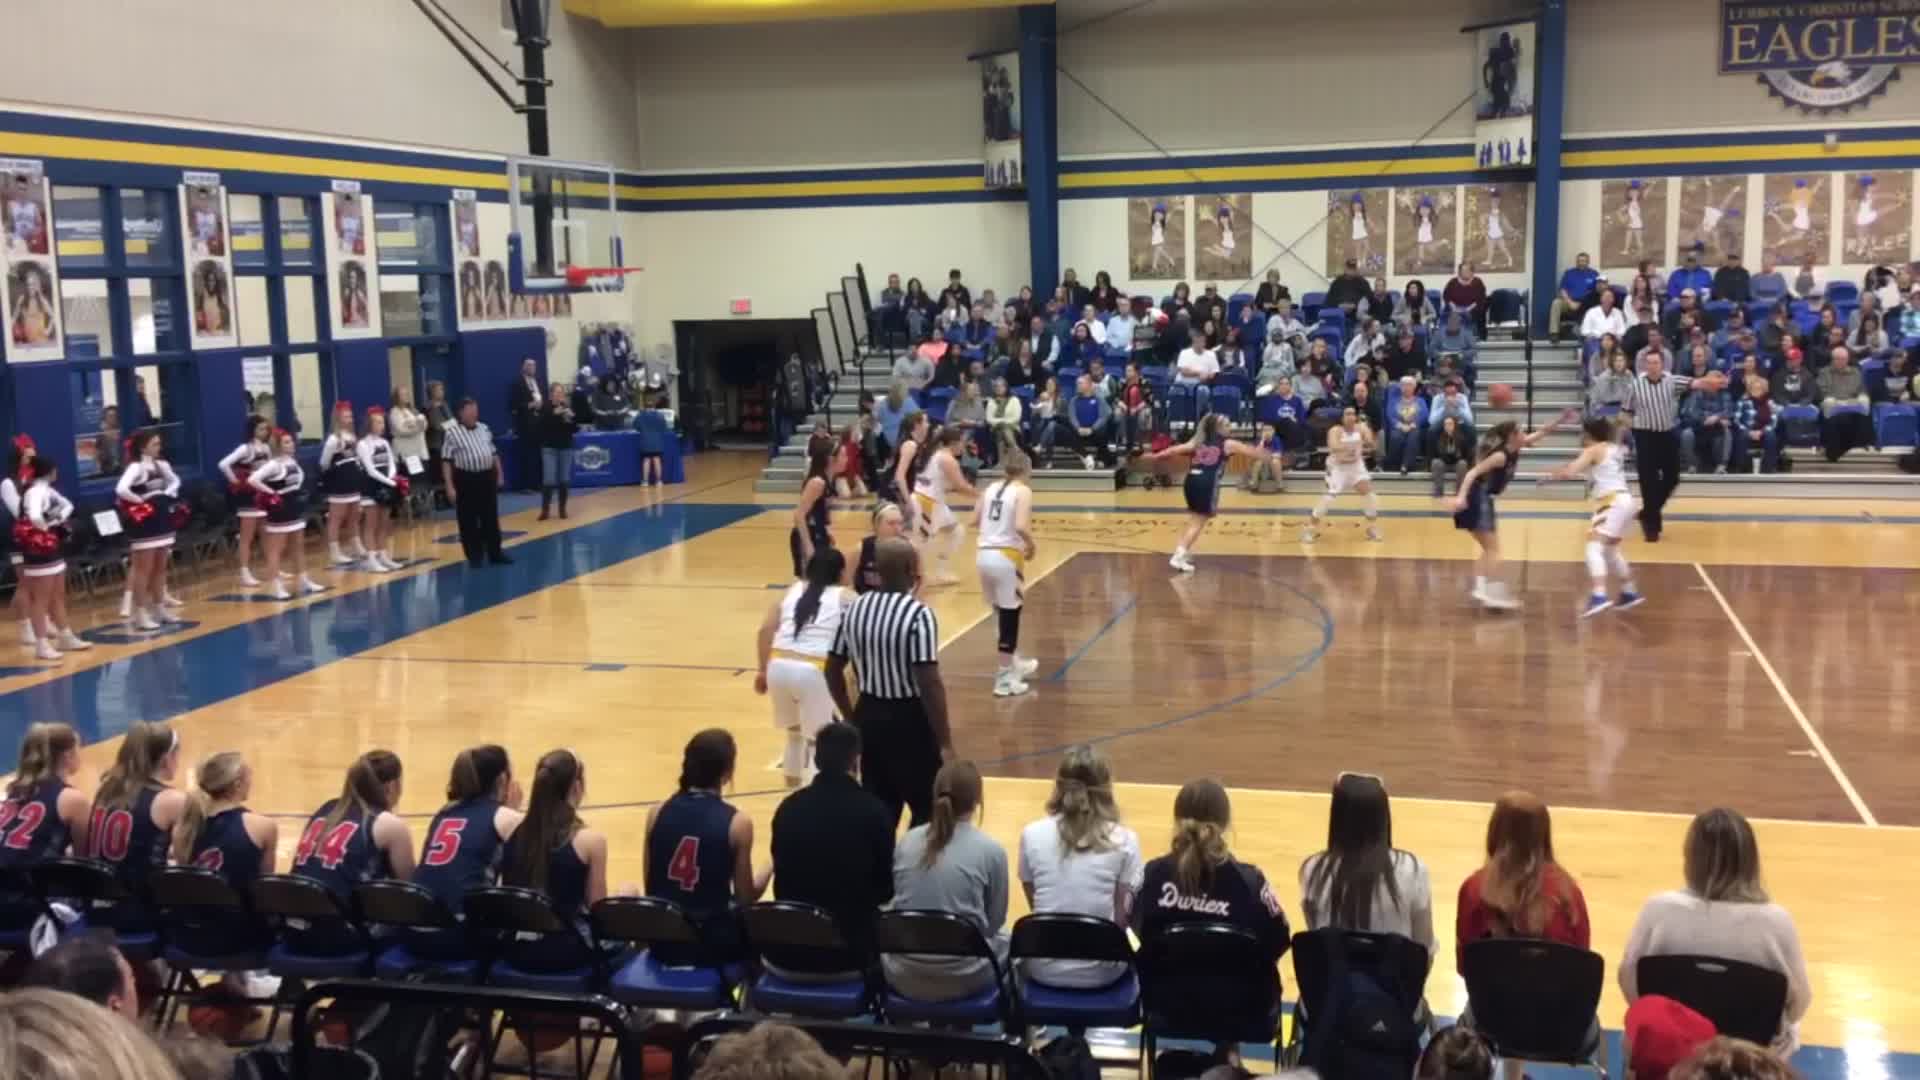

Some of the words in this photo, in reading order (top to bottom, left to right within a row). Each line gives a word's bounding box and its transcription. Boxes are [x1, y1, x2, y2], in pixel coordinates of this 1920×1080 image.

[88, 807, 133, 862] 10
[295, 816, 359, 870] 44
[424, 817, 469, 866] 5
[667, 835, 700, 892] 4
